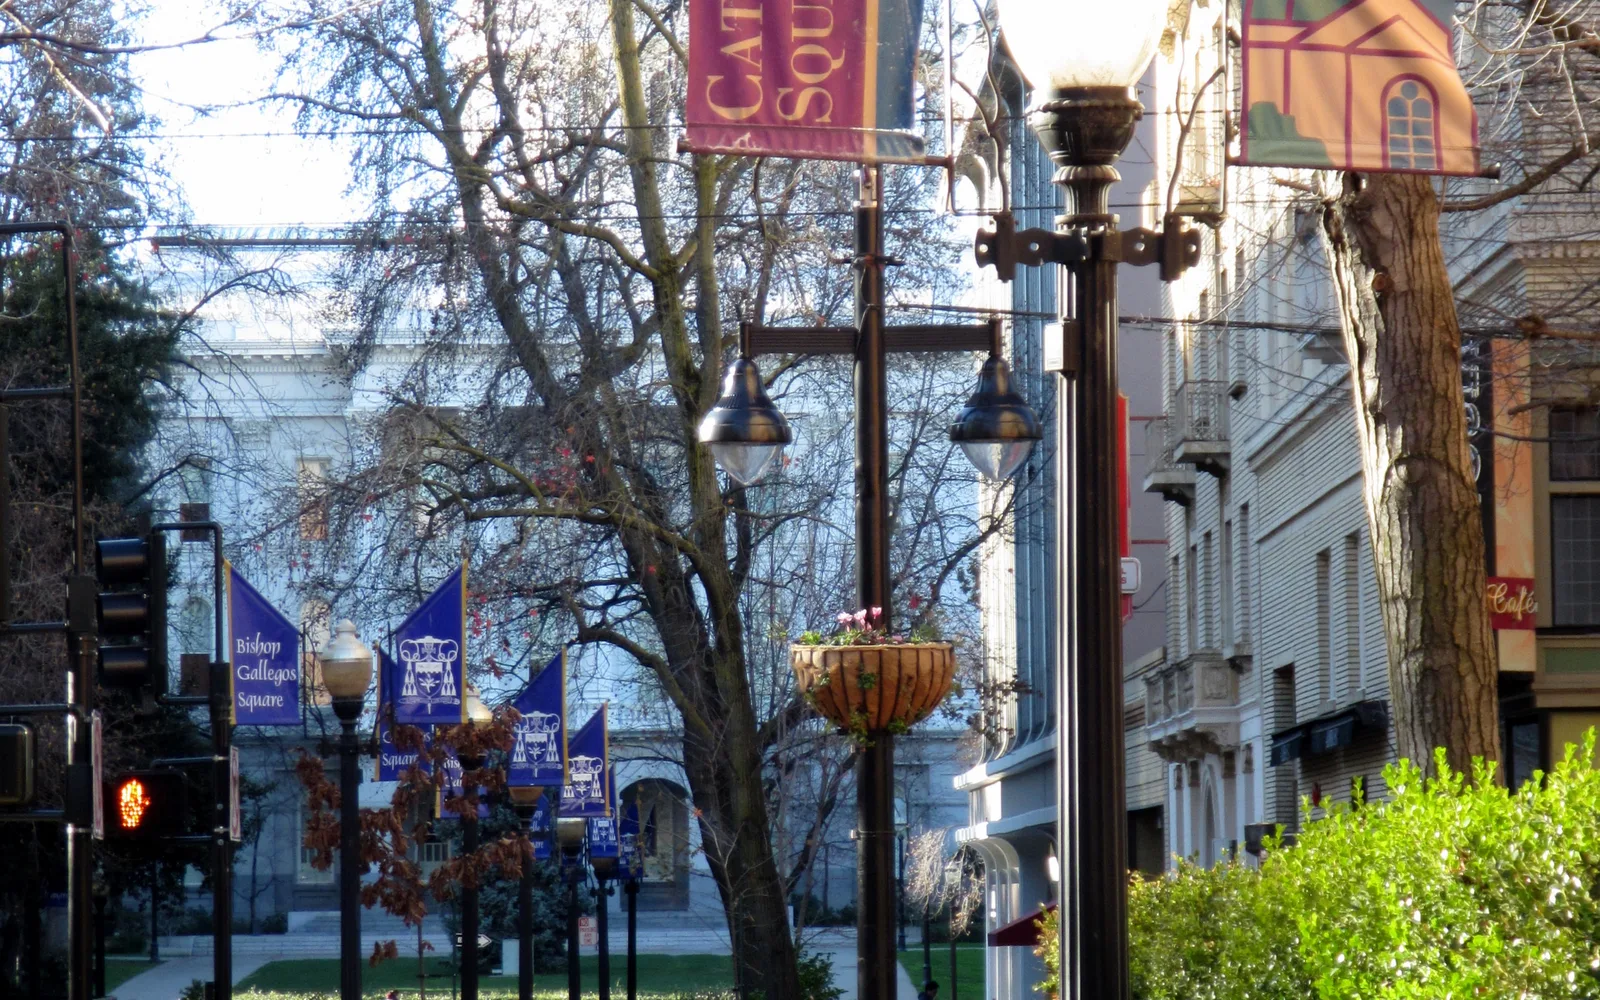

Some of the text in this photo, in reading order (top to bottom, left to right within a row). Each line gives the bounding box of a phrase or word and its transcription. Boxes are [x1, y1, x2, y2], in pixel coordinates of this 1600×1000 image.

[236, 631, 281, 660] Bishop
[237, 659, 297, 687] Gallegos
[238, 691, 284, 713] Square
